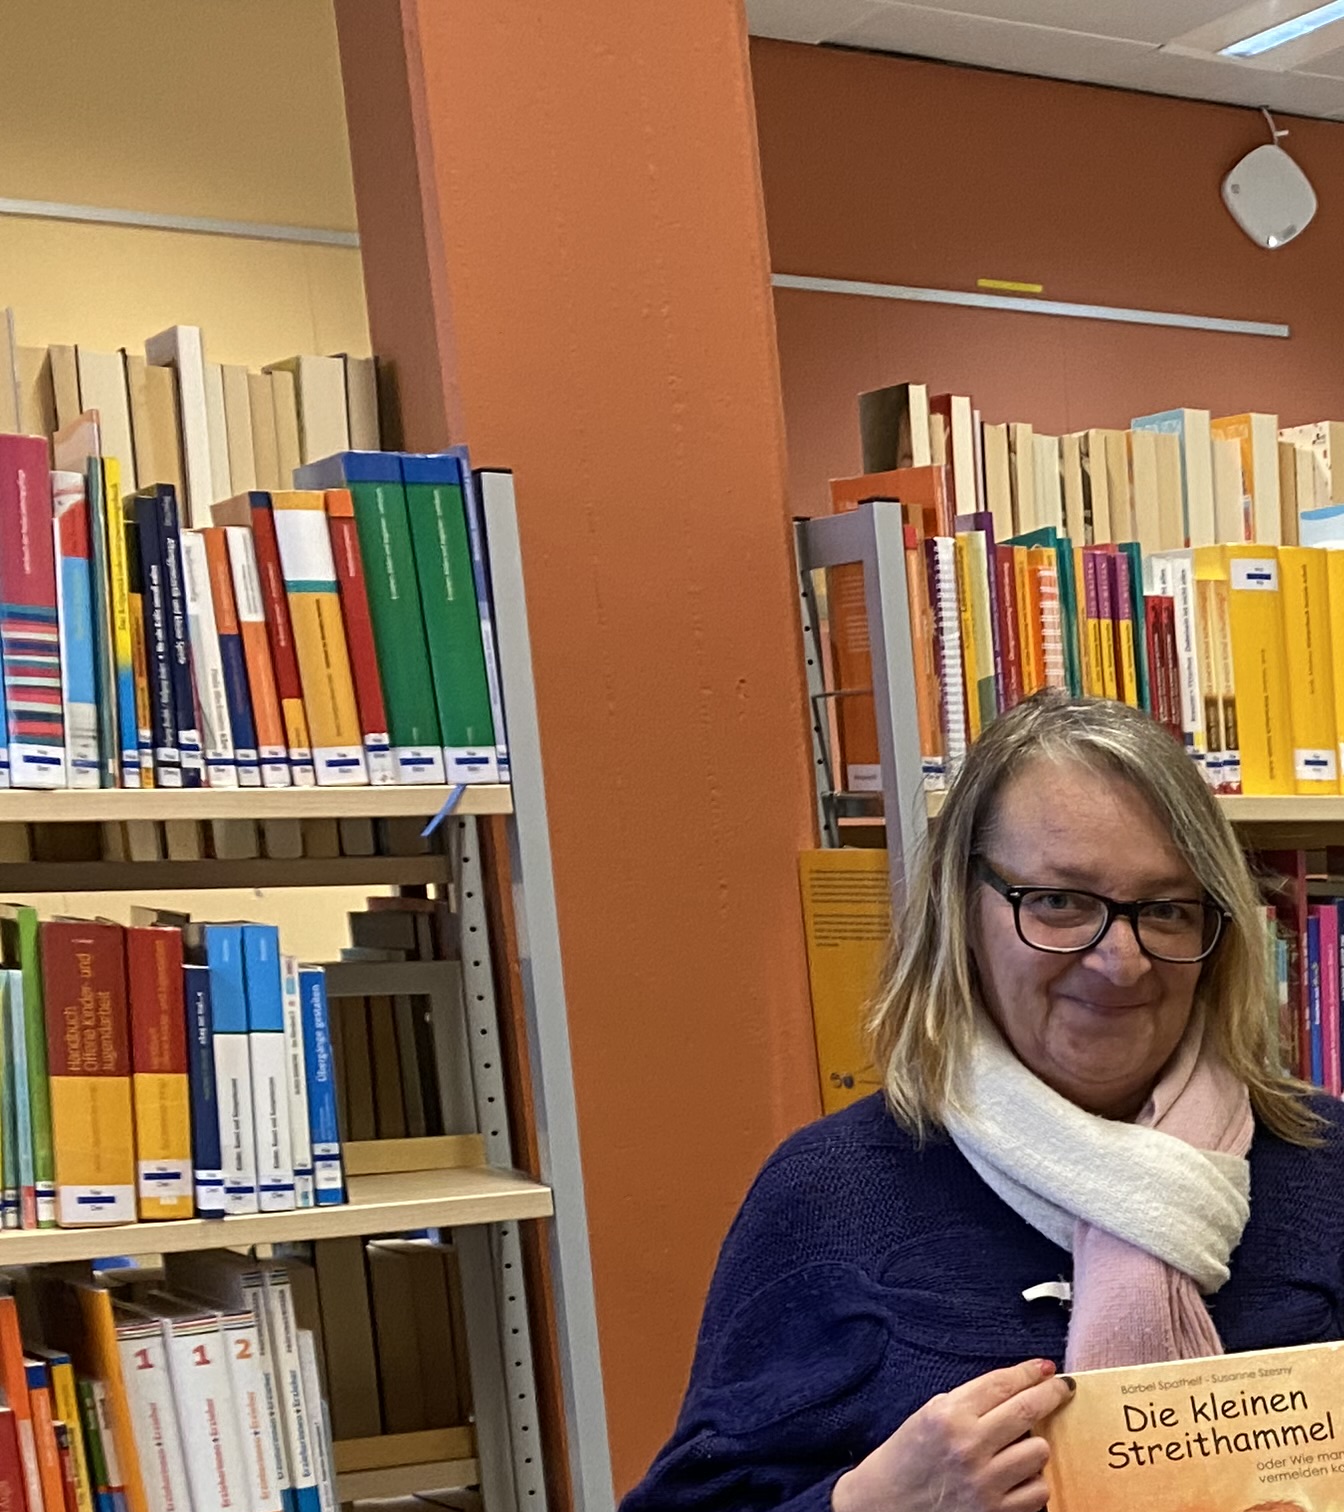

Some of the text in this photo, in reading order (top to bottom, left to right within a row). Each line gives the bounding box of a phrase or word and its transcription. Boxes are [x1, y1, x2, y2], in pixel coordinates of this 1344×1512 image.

[74, 953, 93, 978] und
[64, 1006, 82, 1071] Handbuch
[97, 991, 117, 1072] Jugendarbeit
[309, 983, 328, 1083] Übergänge gestalten
[82, 1028, 98, 1072] Offene
[133, 1348, 155, 1370] 1
[192, 1344, 211, 1367] 1
[234, 1338, 252, 1360] 2
[1120, 1382, 1157, 1395] Bärbel
[1211, 1369, 1257, 1384] Susanne
[1257, 1365, 1294, 1380] Szesny
[1123, 1390, 1309, 1433] Die kleinen
[1108, 1411, 1336, 1470] Streithammel
[1256, 1458, 1287, 1471] oder
[1290, 1452, 1315, 1466] Wie
[1258, 1466, 1330, 1484] vermeiden
